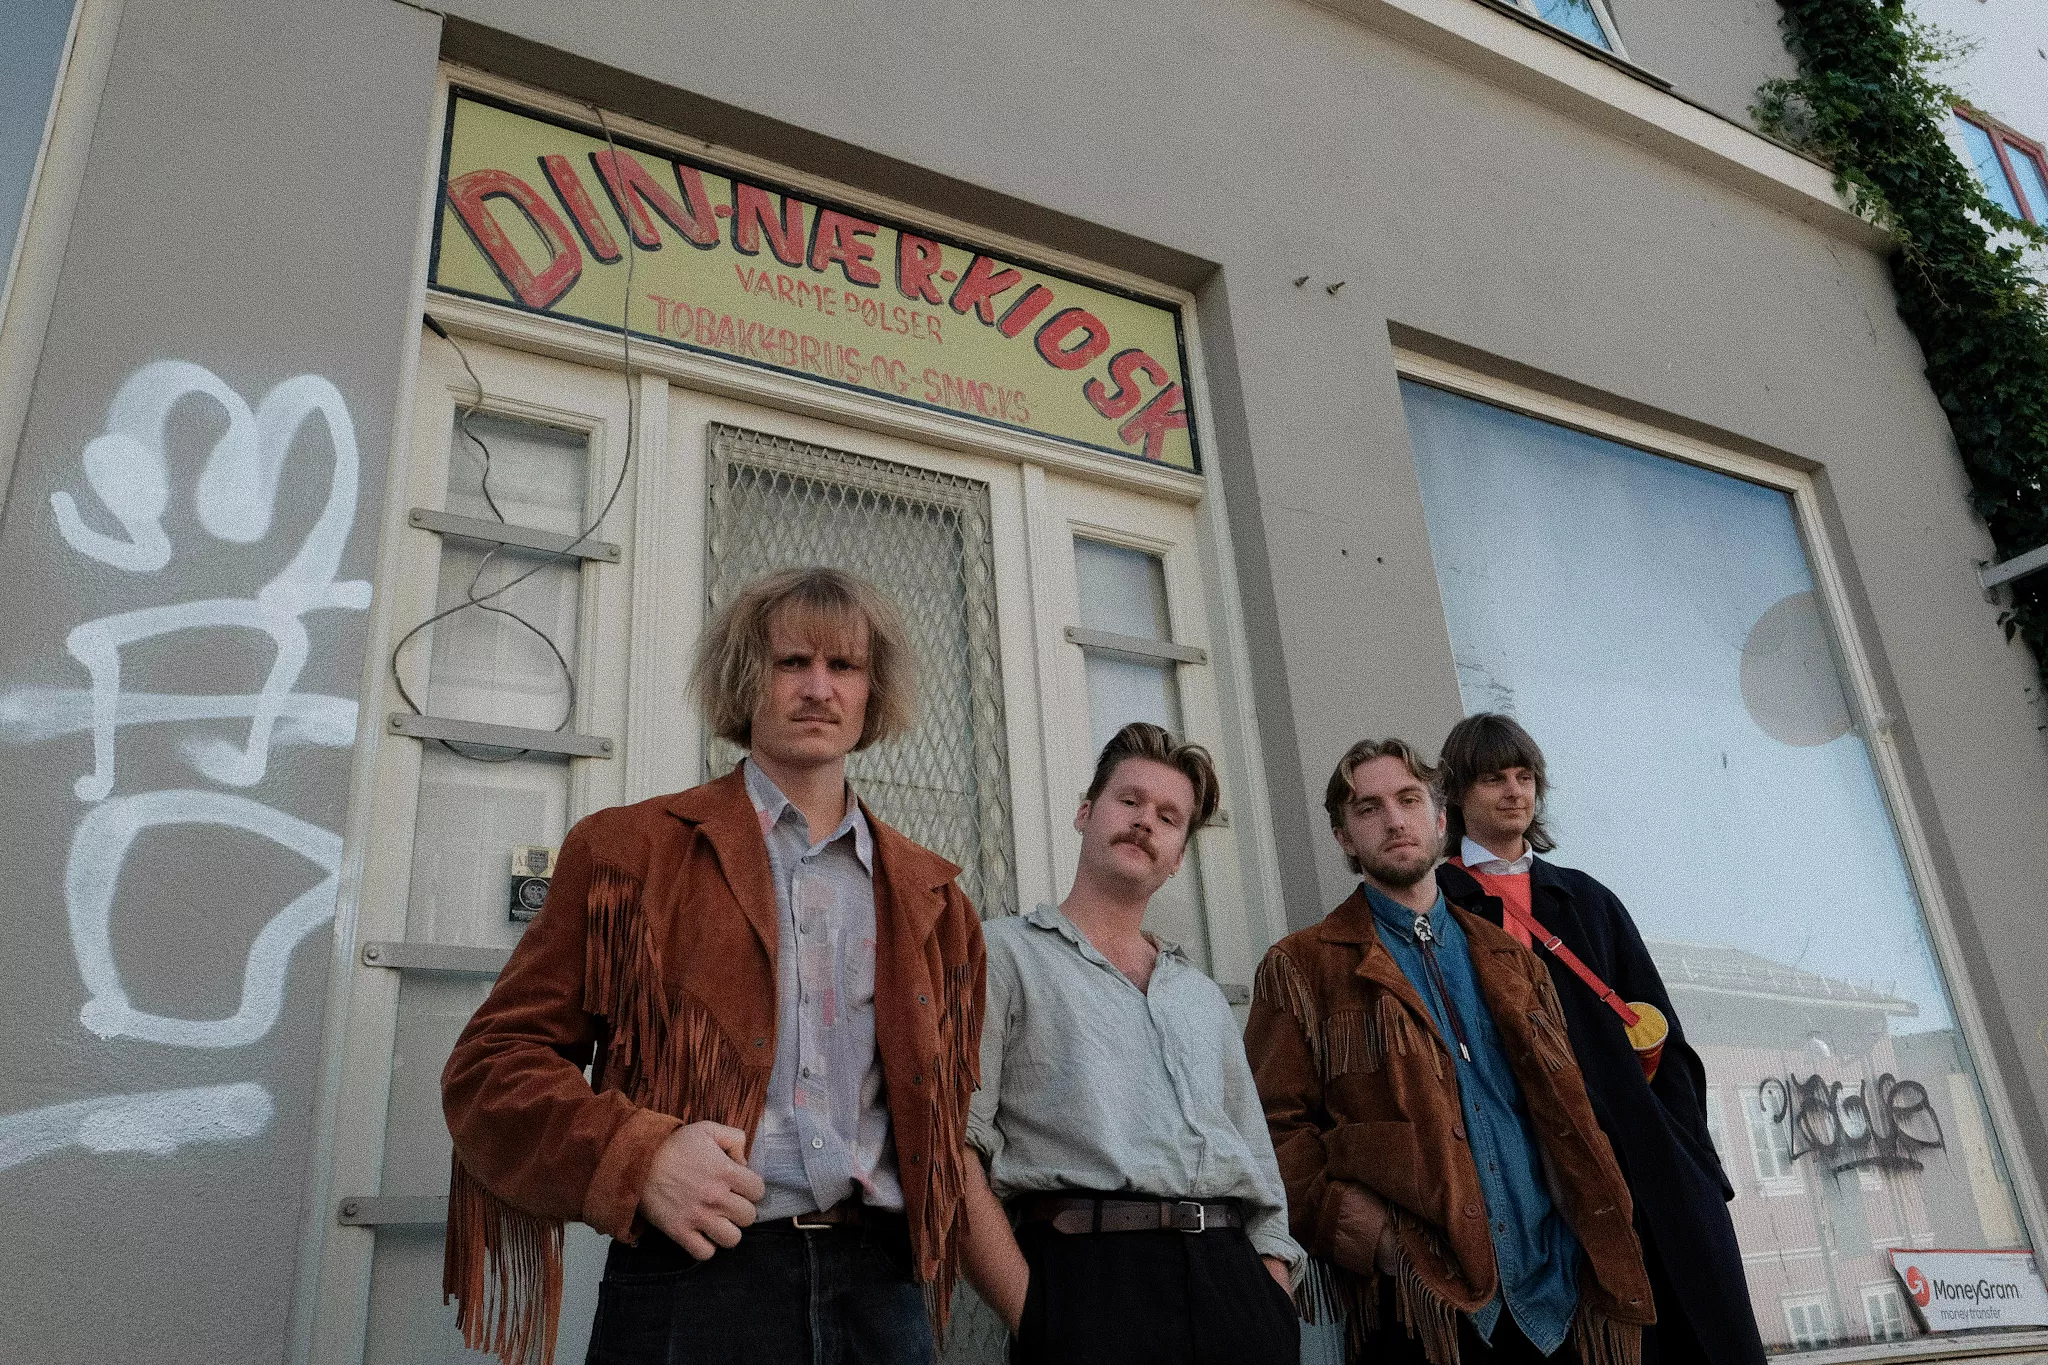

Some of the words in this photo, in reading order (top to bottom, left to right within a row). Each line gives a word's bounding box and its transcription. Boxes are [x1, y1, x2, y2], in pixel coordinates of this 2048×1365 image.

[735, 264, 836, 316] VARME
[844, 291, 943, 344] PØLSER
[1933, 1279, 2020, 1305] MoneyGram
[1940, 1309, 1968, 1321] money
[1969, 1306, 2001, 1320] transfer
